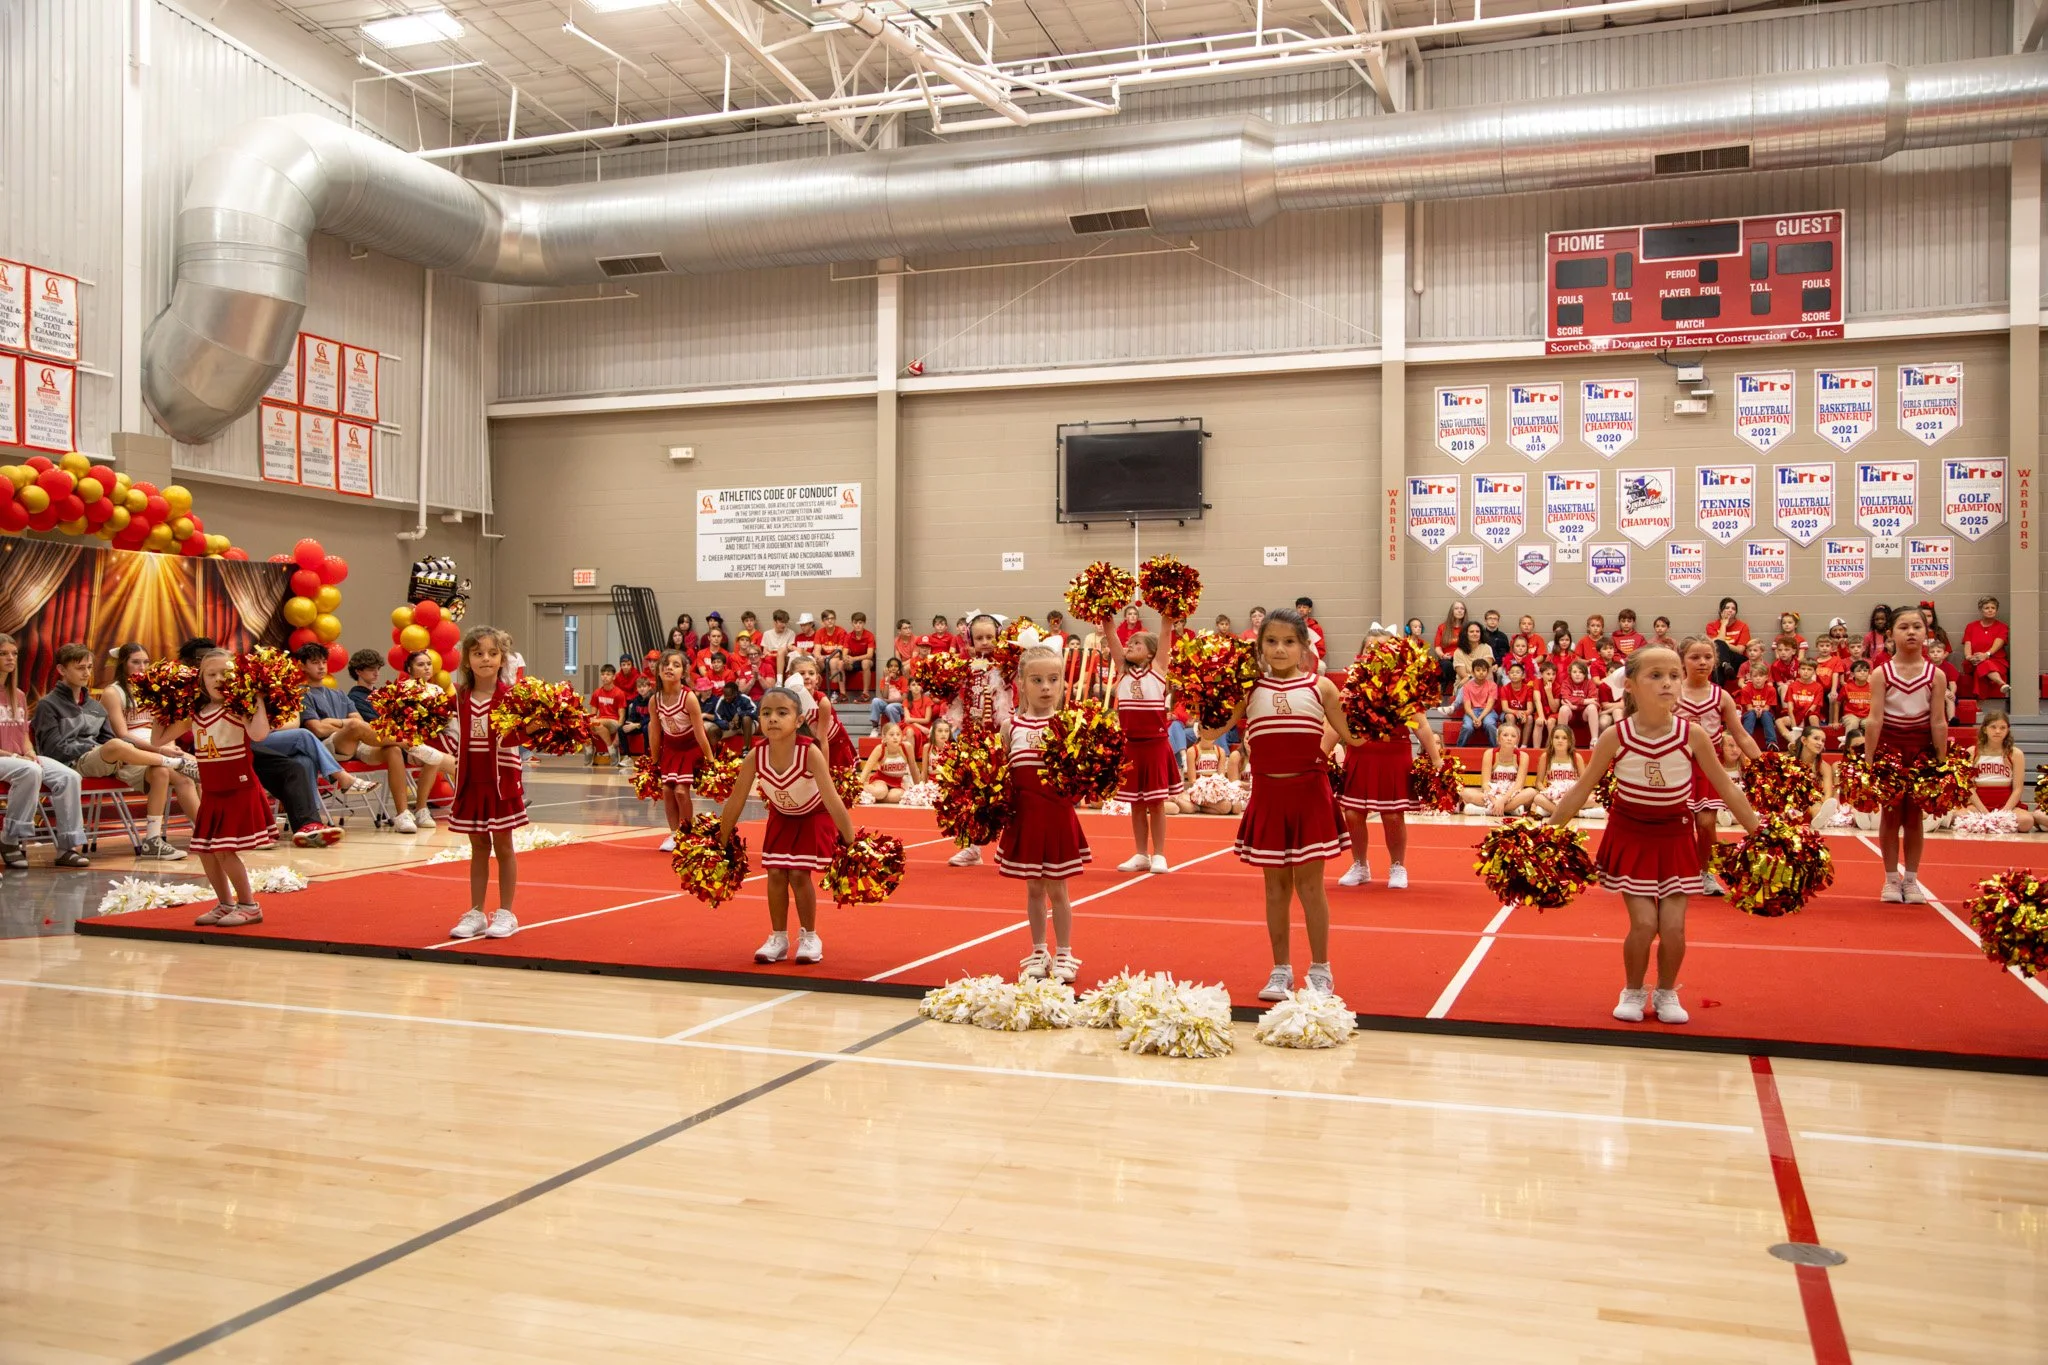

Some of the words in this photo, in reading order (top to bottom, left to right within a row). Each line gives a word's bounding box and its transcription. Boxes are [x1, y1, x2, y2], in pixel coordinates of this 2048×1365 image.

[1776, 216, 1833, 236] GUEST
[1558, 234, 1605, 252] HOME
[1666, 269, 1696, 280] PERIOD
[1750, 282, 1772, 292] T.O.L.
[1802, 278, 1830, 289] FOULS
[1611, 291, 1632, 302] T.O.L.
[1660, 287, 1691, 298] PLAYER
[1700, 286, 1722, 296] FOUL
[1557, 294, 1583, 304] FOULS
[1802, 311, 1830, 322] SCORE
[1676, 318, 1704, 330] MATCH
[35, 326, 71, 340] CHAMPION
[1556, 326, 1584, 336] SCORE
[1550, 339, 1608, 352] Scoreboard
[1612, 338, 1656, 350] Donated
[1660, 336, 1673, 348] by
[1676, 334, 1713, 346] Electra
[1716, 330, 1787, 344] Construction
[1790, 328, 1812, 340] Co.,
[1816, 327, 1838, 338] Inc.
[1820, 402, 1872, 413] BASKETBALL
[1903, 400, 1922, 408] GIRLS
[1922, 398, 1957, 408] ATHLETICS
[1740, 405, 1790, 416] VOLLEYBALL
[1903, 406, 1957, 419] CHAMPION
[1512, 416, 1558, 426] VOLLEYBALL
[1586, 412, 1633, 422] VOLLEYBALL
[1739, 414, 1790, 426] CHAMPION
[1820, 412, 1872, 424] RUNNERUP
[1440, 420, 1454, 428] SAND
[1454, 418, 1485, 428] VOLLEYBALL
[1585, 422, 1632, 432] CHAMPION
[1916, 420, 1942, 430] 2021
[1440, 427, 1486, 438] CHAMPIONS
[1512, 424, 1558, 436] CHAMPION
[1751, 427, 1777, 436] 2021
[1832, 425, 1858, 434] 2021
[1596, 434, 1622, 442] 2020
[1451, 440, 1474, 450] 2018
[1526, 444, 1546, 452] 2018
[719, 490, 761, 502] ATHLETICS
[764, 488, 784, 500] CODE
[787, 488, 797, 499] OF
[800, 486, 837, 499] CONDUCT
[1958, 493, 1990, 504] GOLF
[1700, 498, 1750, 508] TENNIS
[1778, 497, 1830, 508] VOLLEYBALL
[1860, 496, 1914, 506] VOLLEYBALL
[1410, 507, 1456, 517] VOLLEYBALL
[1476, 506, 1522, 515] BASKETBALL
[1548, 503, 1595, 513] BASKETBALL
[1778, 506, 1830, 518] CHAMPION
[1860, 505, 1912, 516] CHAMPION
[1946, 503, 2002, 515] CHAMPION
[2017, 469, 2032, 550] WARRIORS
[1548, 512, 1596, 524] CHAMPIONS
[1700, 508, 1750, 520] CHAMPION
[1387, 490, 1398, 560] WARRIORS
[1410, 516, 1456, 527] CHAMPION
[1476, 516, 1522, 525] CHAMPIONS
[1622, 517, 1670, 528] CHAMPION
[1712, 521, 1738, 530] 2023
[1791, 520, 1818, 528] 2023
[1872, 518, 1900, 527] 2024
[1960, 516, 1988, 525] 2025
[1422, 528, 1446, 536] 2022
[1486, 528, 1510, 536] 2022
[1560, 525, 1584, 534] 2022
[577, 572, 592, 584] EXIT
[1272, 693, 1292, 715] CA
[197, 728, 221, 759] CA
[1644, 762, 1666, 786] CA
